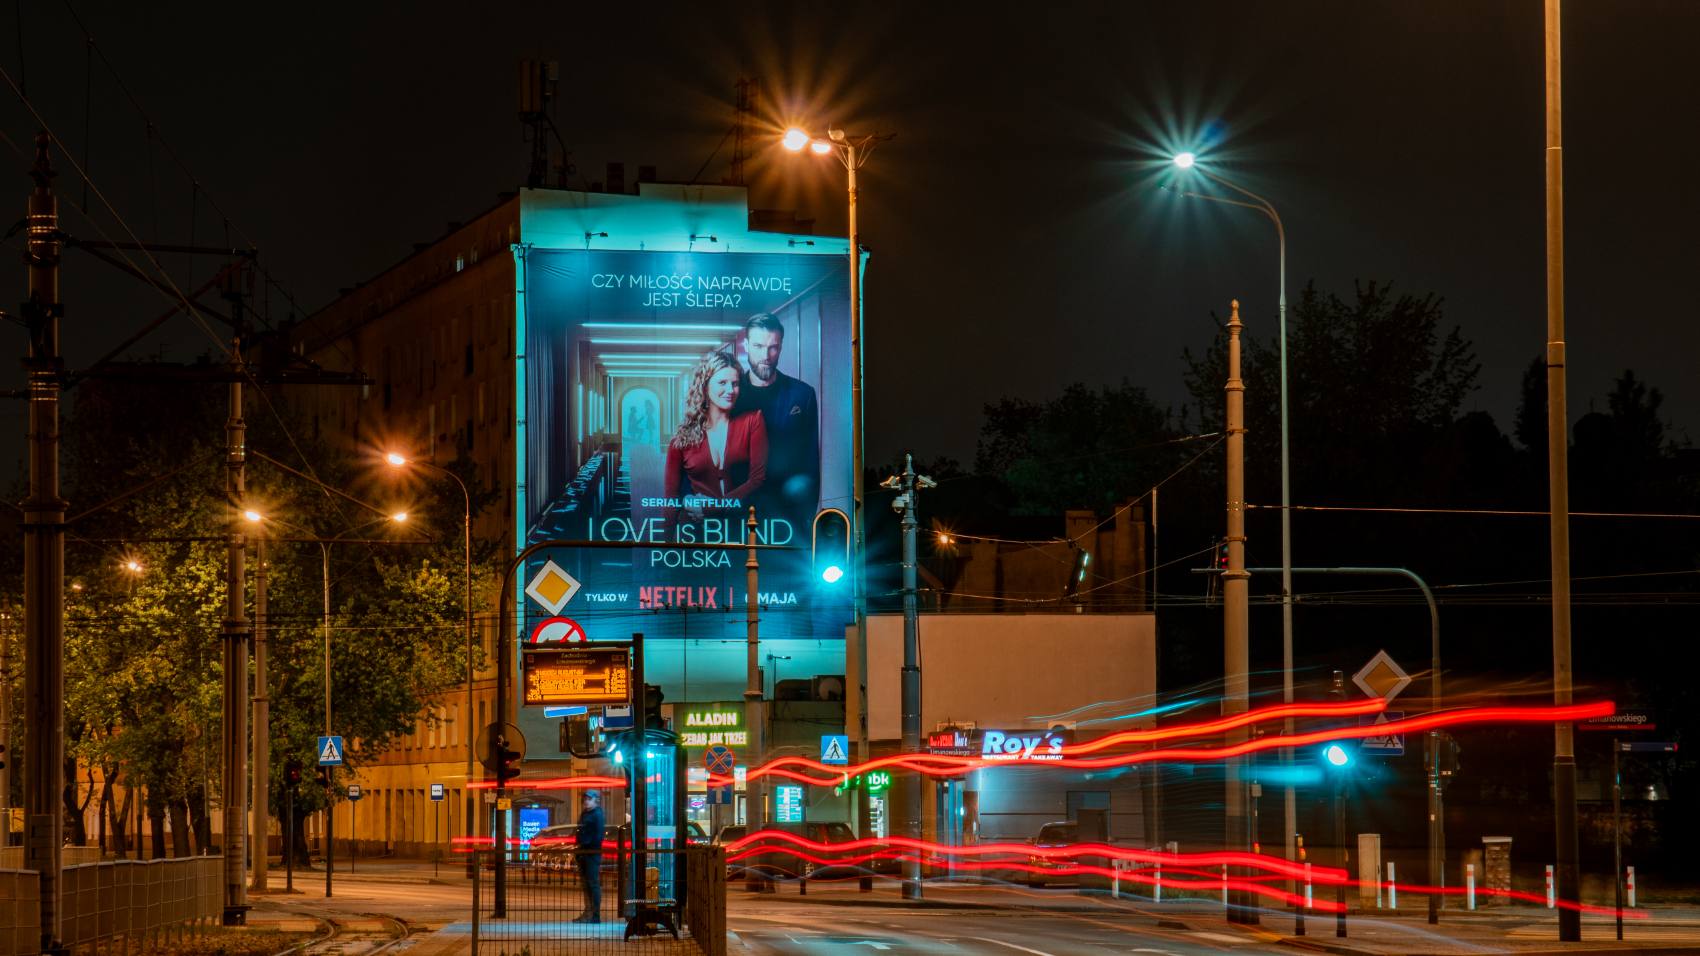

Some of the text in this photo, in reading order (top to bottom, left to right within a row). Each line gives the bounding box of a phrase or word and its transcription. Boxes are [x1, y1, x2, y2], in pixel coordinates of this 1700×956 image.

[591, 272, 793, 295] CZY MIŁOŚĆ NAPRAWDĘ
[642, 290, 742, 308] JEST ŚLEPA?
[641, 497, 741, 508] SERIAL NETFLIXA
[676, 523, 696, 544] IS
[703, 518, 793, 545] BLIND
[651, 550, 732, 568] POLSKA
[585, 586, 717, 609] TYLKO W NETFLIX
[757, 592, 798, 604] MAJA
[686, 712, 737, 726] ALADIN
[982, 731, 1064, 760] Roy's
